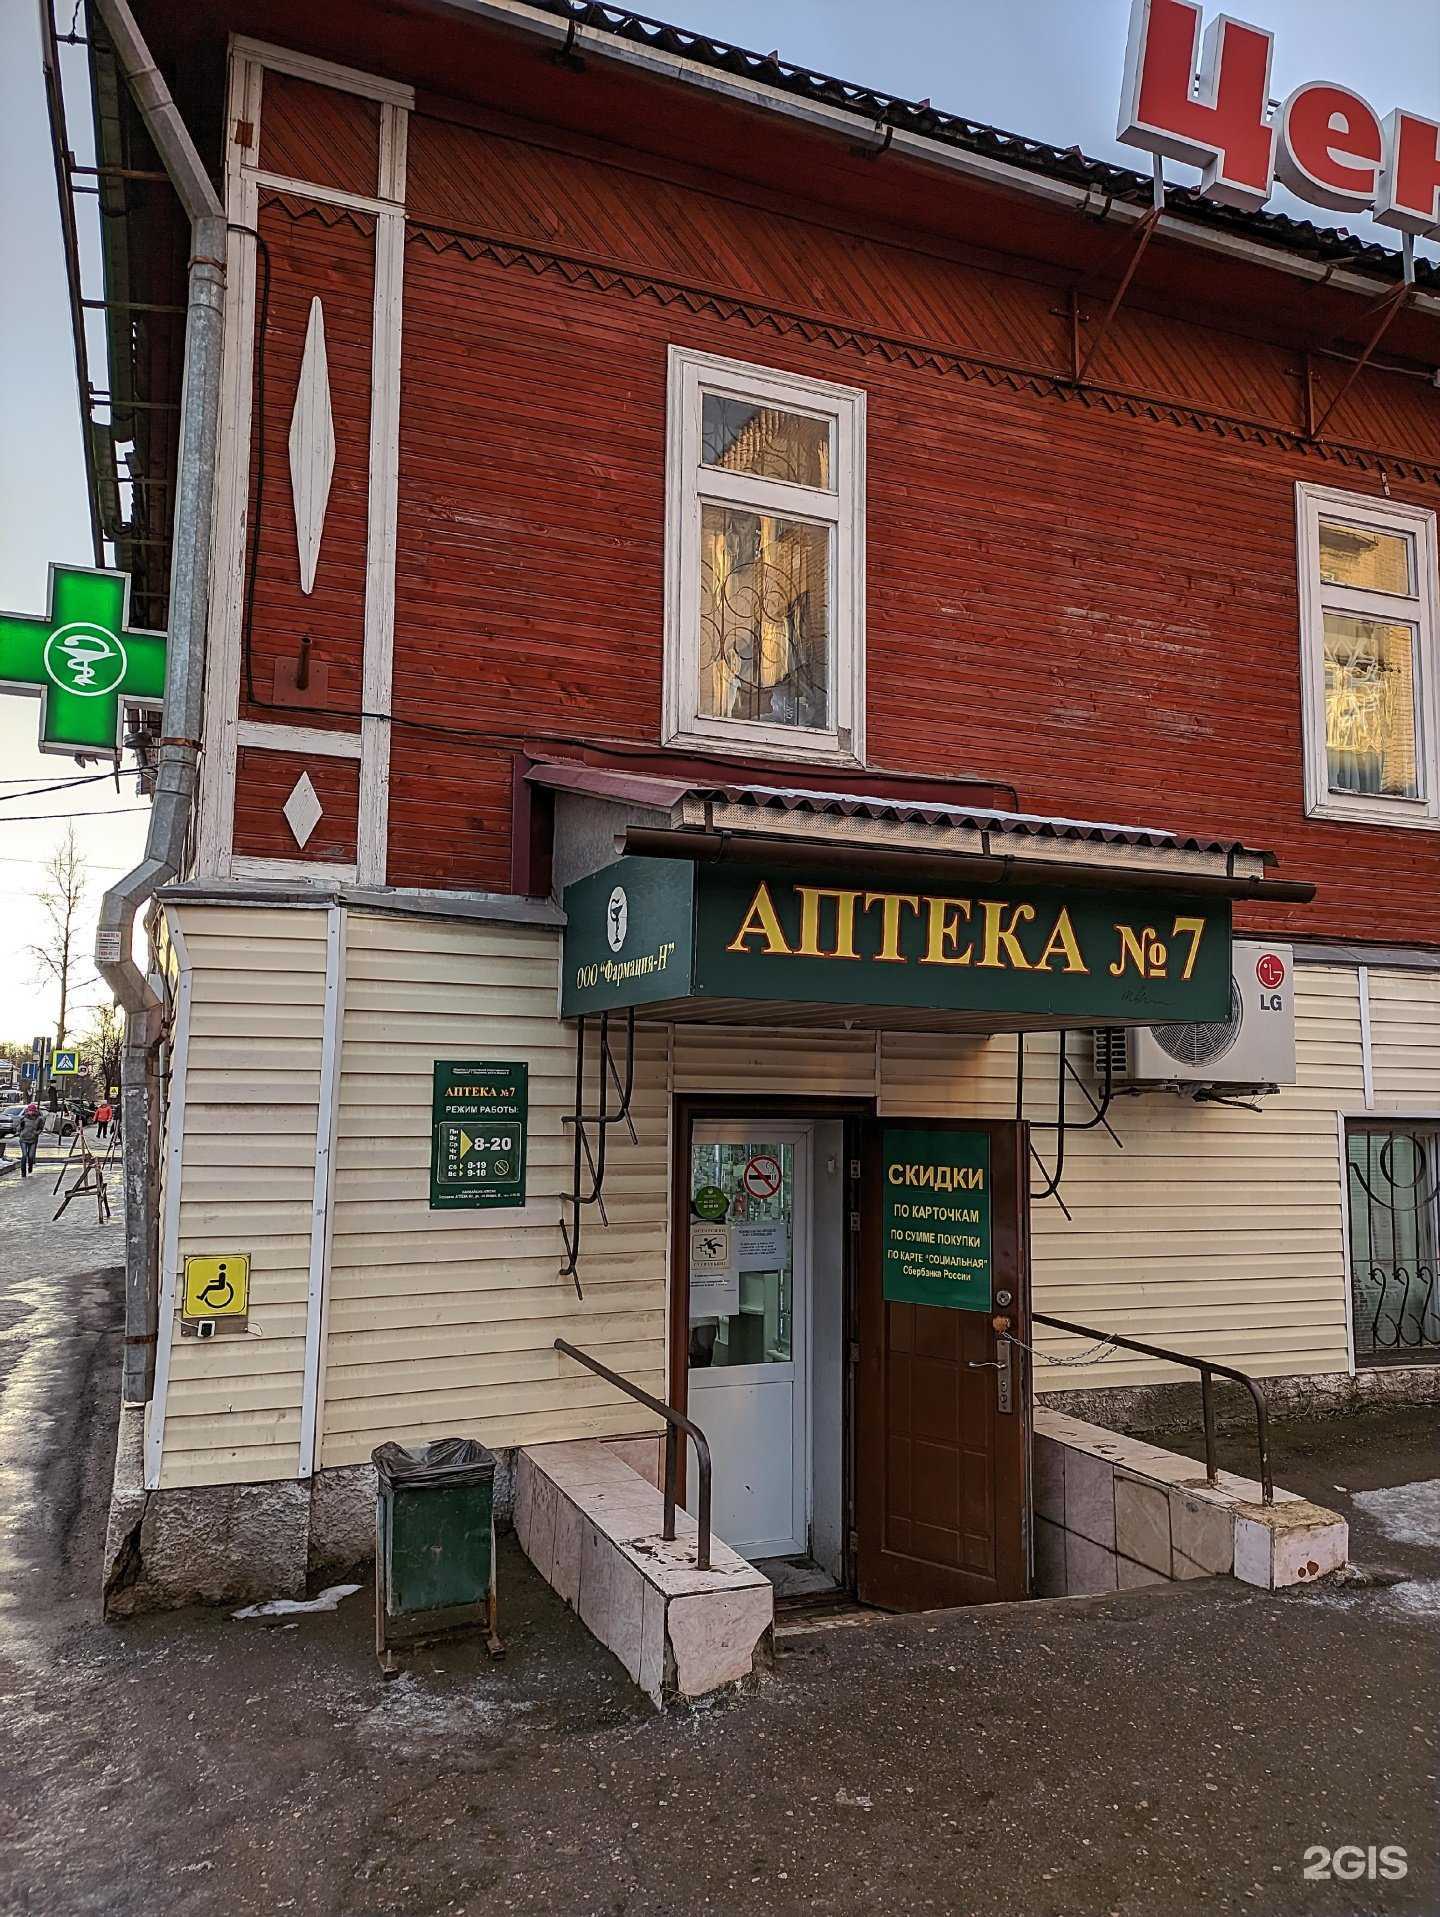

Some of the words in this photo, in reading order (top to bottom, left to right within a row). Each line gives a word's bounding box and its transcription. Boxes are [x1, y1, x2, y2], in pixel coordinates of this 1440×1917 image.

[725, 880, 1091, 975] АПТЕКА
[576, 963, 598, 989] ООО
[1260, 994, 1283, 1011] LG
[444, 1086, 498, 1097] АПТЕКА
[445, 1105, 478, 1114] РЕЖИМ
[480, 1105, 519, 1114] РАБОТЫ:
[474, 1137, 512, 1151] 8-20
[888, 1163, 984, 1192] СКИДКИ
[894, 1203, 910, 1218] ПО
[912, 1205, 979, 1223] КАРТОЧКАМ
[890, 1229, 904, 1241] ПО
[905, 1230, 936, 1244] СУММЕ
[937, 1233, 981, 1248] ПОКУПКИ
[887, 1249, 899, 1259] ПО
[900, 1251, 924, 1263] КАРТЕ
[903, 1265, 942, 1278] Сбербанка
[943, 1269, 971, 1281] России
